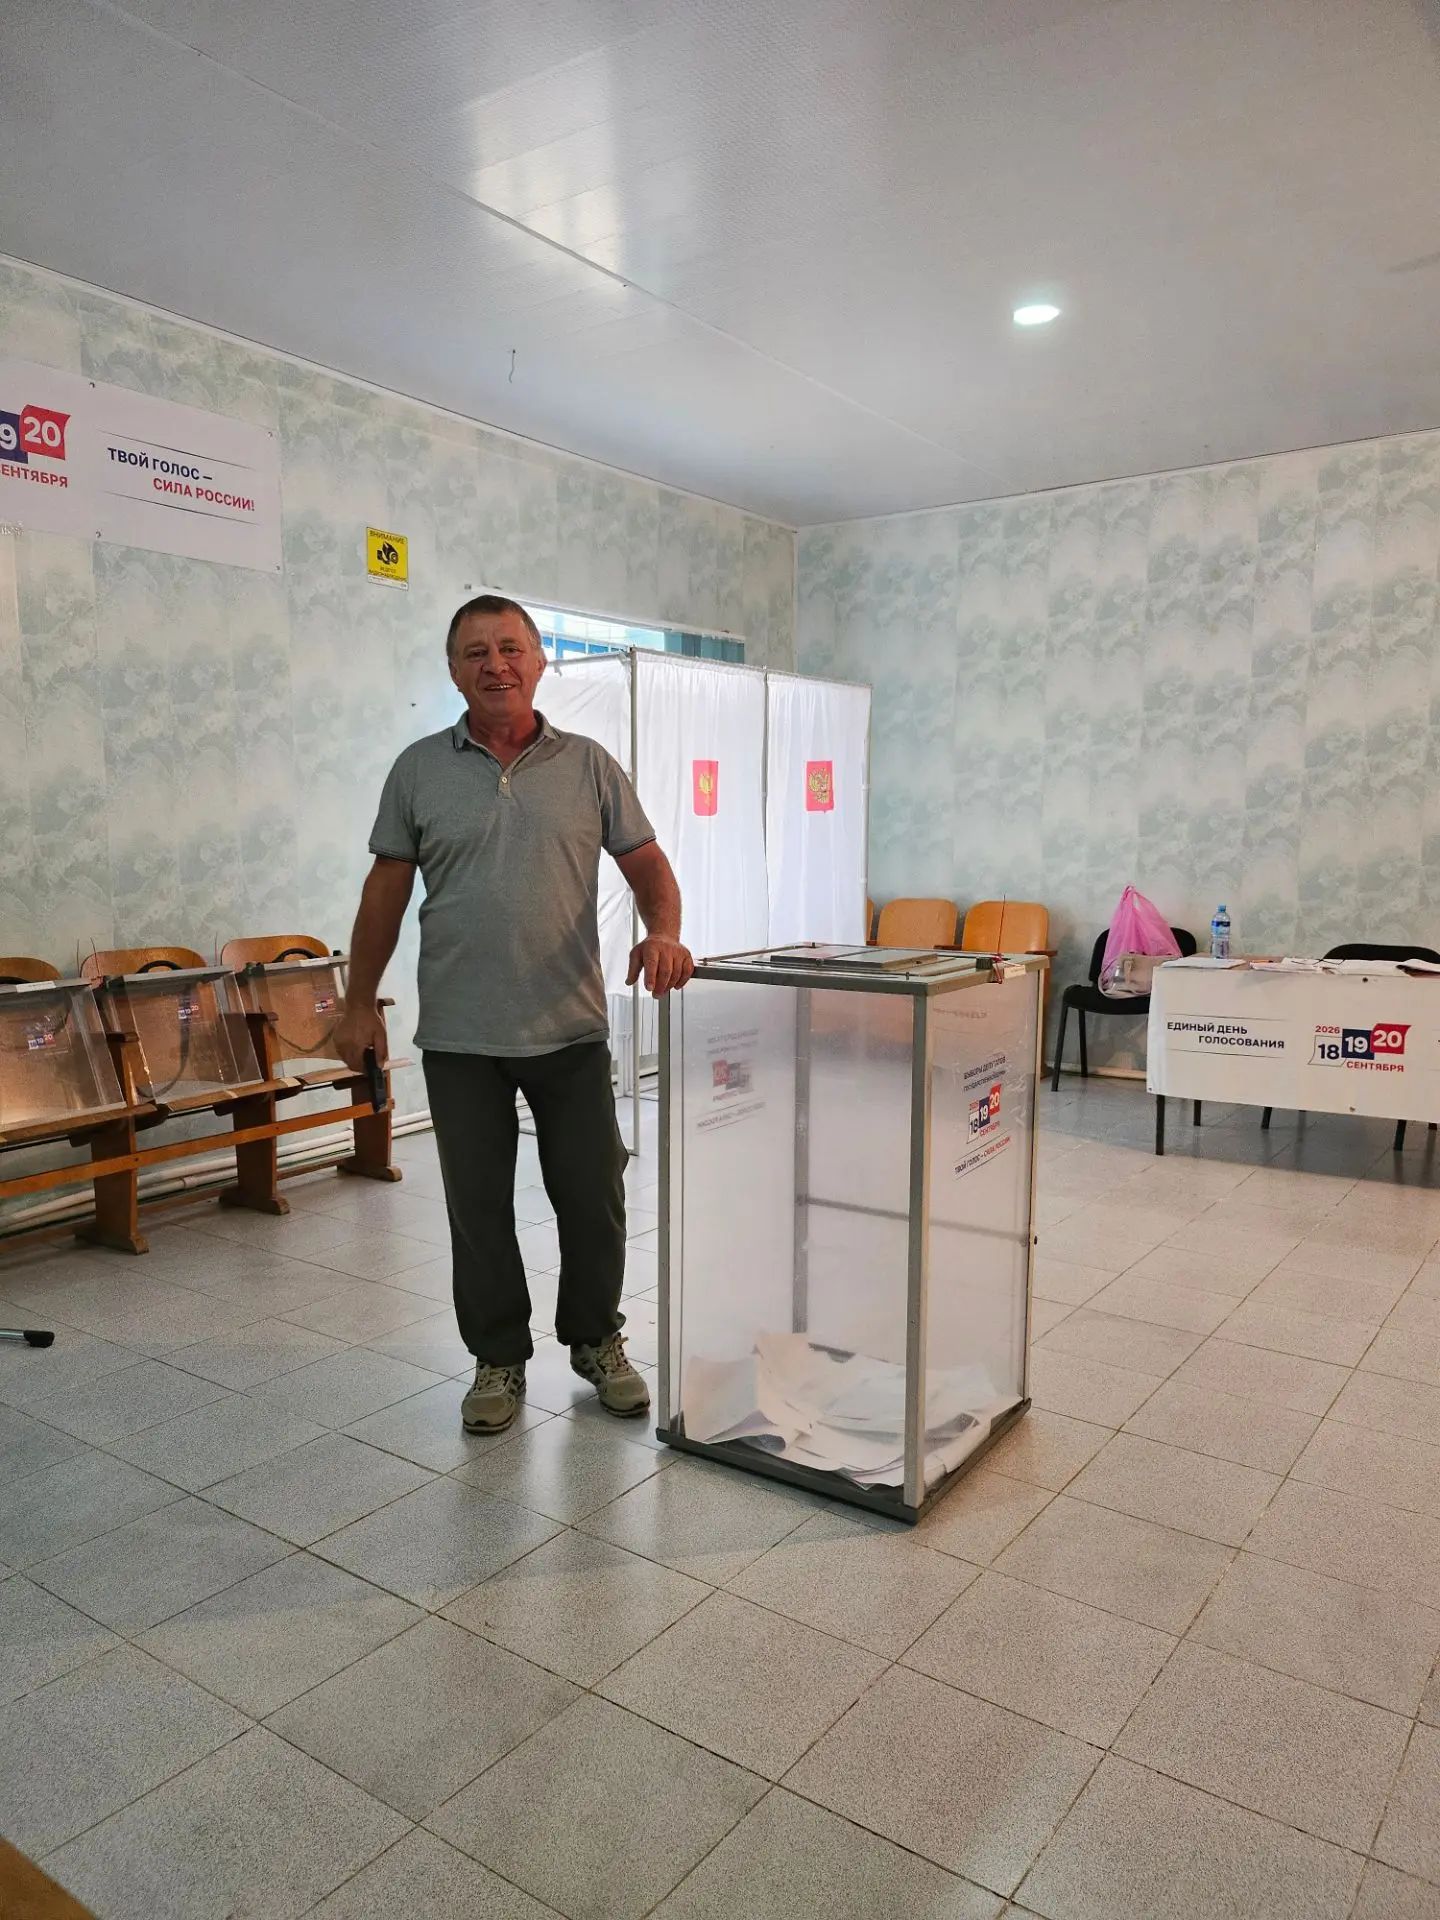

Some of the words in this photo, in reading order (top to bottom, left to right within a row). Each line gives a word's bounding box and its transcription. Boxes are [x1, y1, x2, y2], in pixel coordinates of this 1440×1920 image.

[23, 416, 62, 447] 20
[0, 464, 68, 488] ЕНТЯБРЯ
[107, 447, 149, 469] ТВОЙ
[152, 458, 200, 480] ГОЛОС
[153, 477, 193, 497] СИЛА
[195, 487, 255, 511] РОССИИ!
[1167, 1021, 1215, 1033] ЕДИНЫЙ
[1216, 1025, 1248, 1035] ДЕНЬ
[1315, 1025, 1340, 1034] 2026
[1198, 1035, 1285, 1049] ГОЛОСОВАНИЯ
[1318, 1043, 1340, 1060] 18
[1345, 1036, 1369, 1053] 19
[1373, 1029, 1403, 1048] 20
[1346, 1061, 1404, 1072] СЕНТЯБРЯ
[969, 1118, 979, 1135] 18
[980, 1104, 989, 1121] 19
[989, 1092, 1000, 1110] 20
